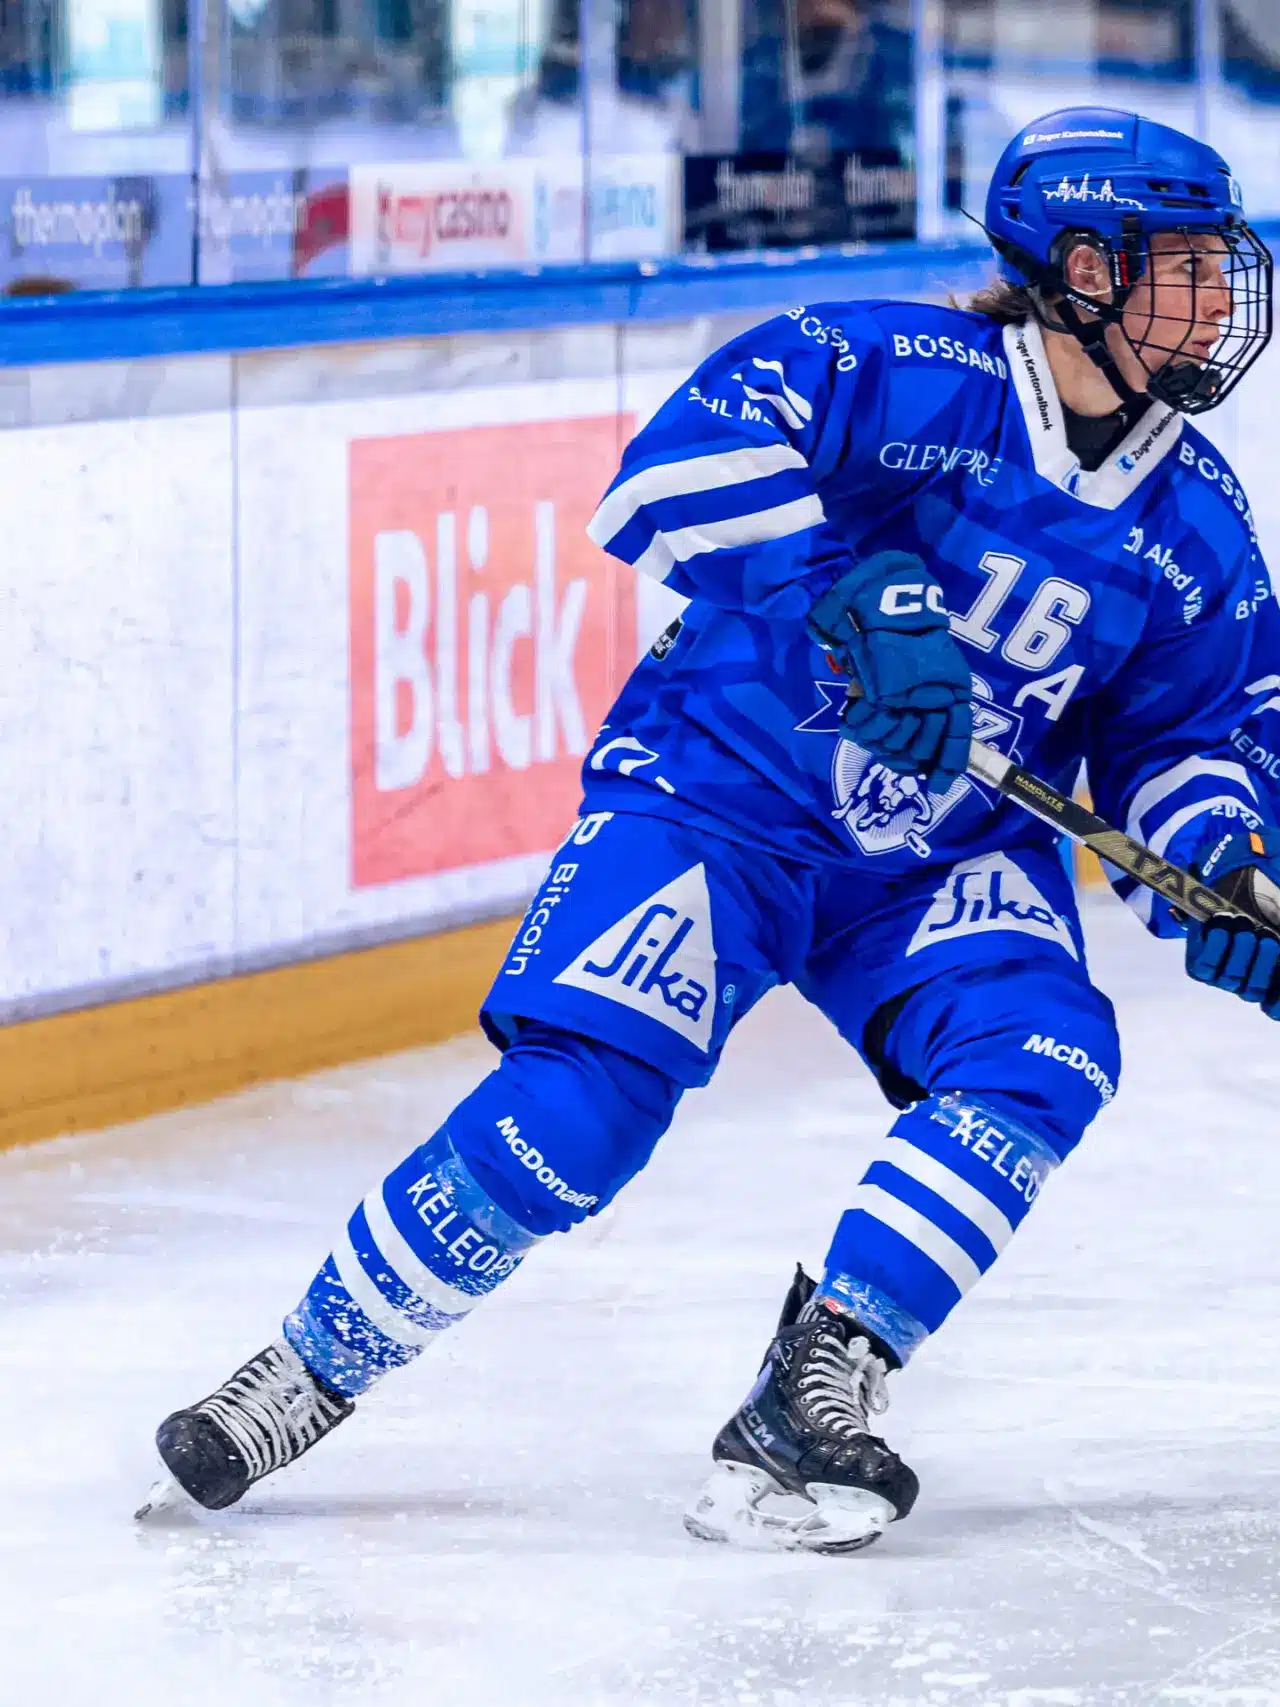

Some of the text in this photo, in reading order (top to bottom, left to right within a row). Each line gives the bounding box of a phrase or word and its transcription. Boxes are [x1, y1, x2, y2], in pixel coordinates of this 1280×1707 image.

[892, 333, 1008, 380] BOSSARD
[1023, 358, 1054, 432] Kantonalbank
[1131, 408, 1180, 461] Zuger Kanton
[373, 499, 589, 793] Blick
[947, 551, 1091, 672] 16
[1012, 663, 1087, 722] A
[1015, 774, 1065, 813] NANOLITE
[1125, 838, 1225, 914] TAC
[1201, 833, 1234, 877] CCM
[504, 862, 580, 977] Bitcoin
[928, 870, 1060, 932] Sika
[582, 903, 709, 1023] Sika
[949, 1110, 1041, 1203] KELEO
